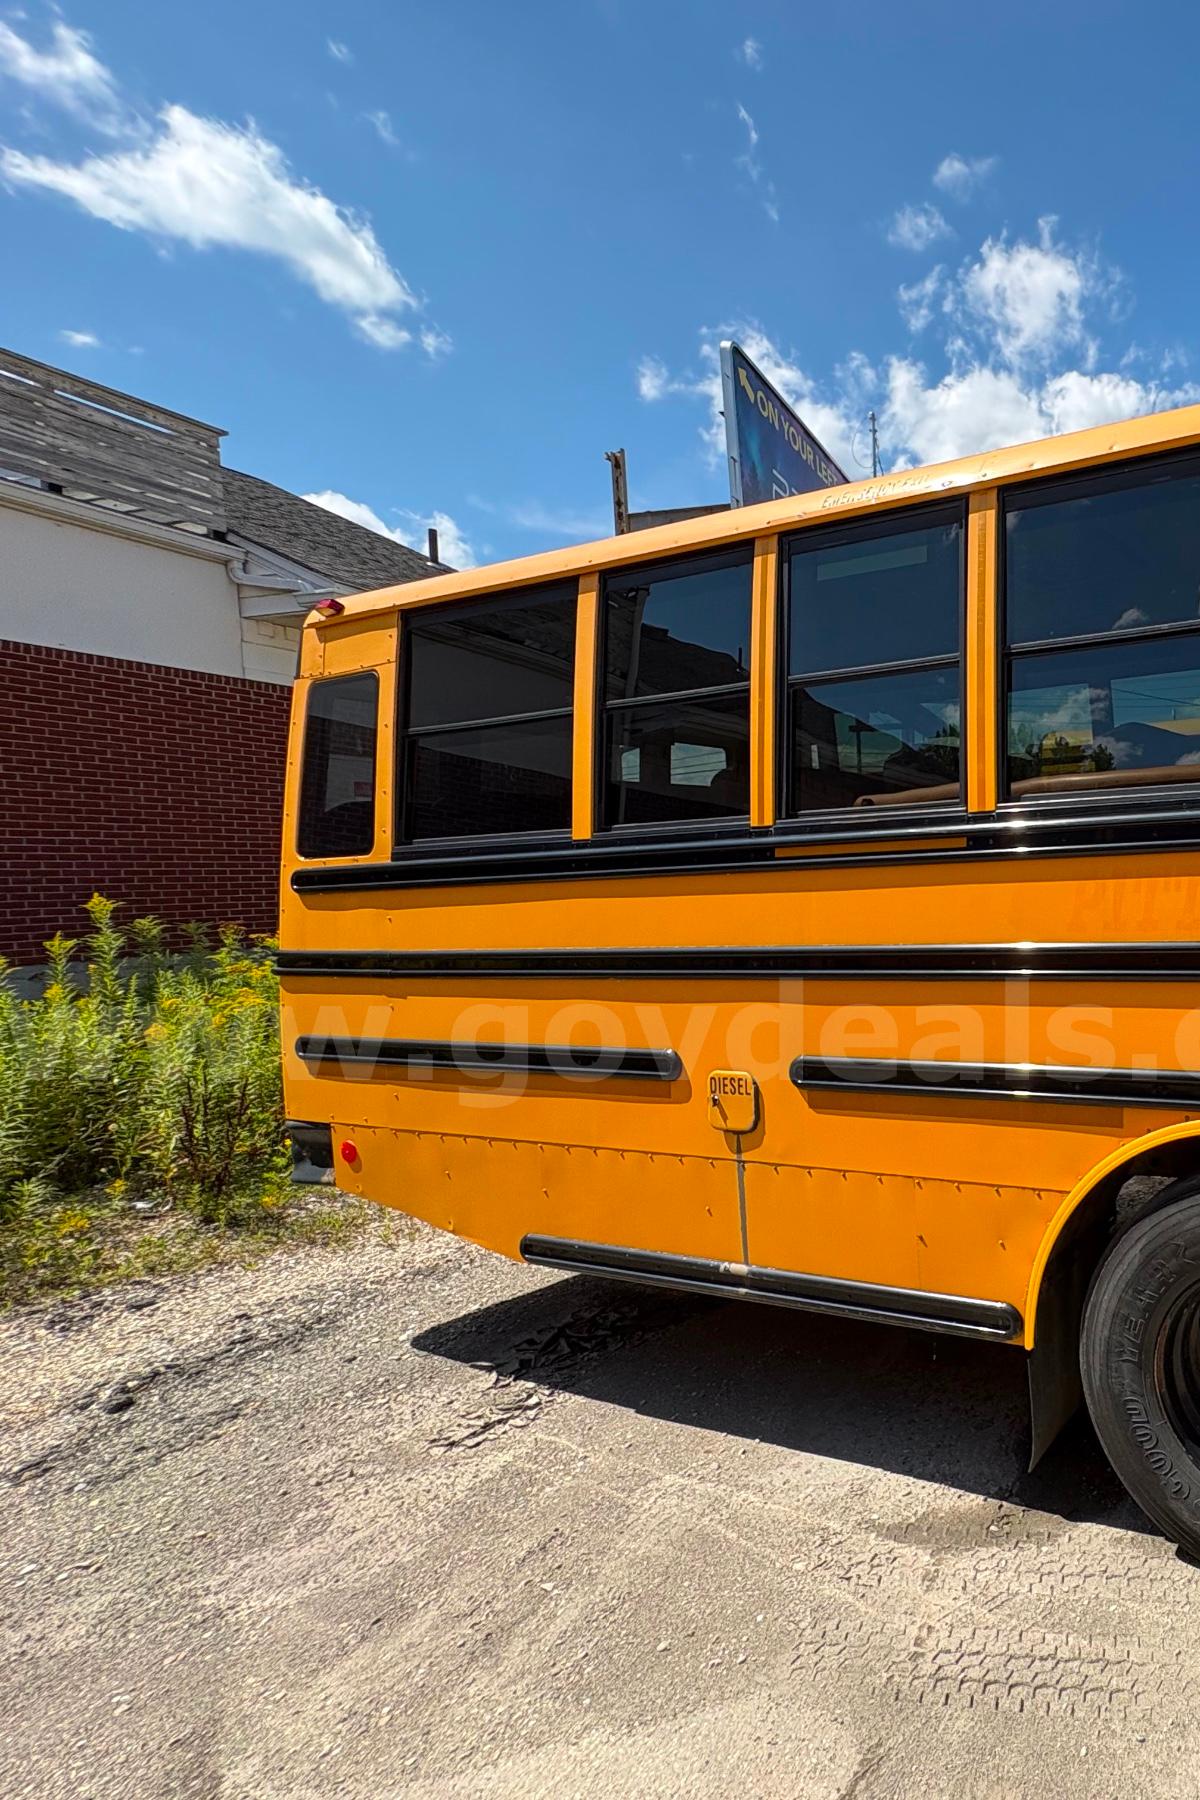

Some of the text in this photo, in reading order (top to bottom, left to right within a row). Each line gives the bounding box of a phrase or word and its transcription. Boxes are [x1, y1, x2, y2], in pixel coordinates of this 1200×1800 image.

[756, 390, 780, 431] ON
[781, 415, 815, 471] YOUR
[709, 1076, 752, 1096] DIESEL
